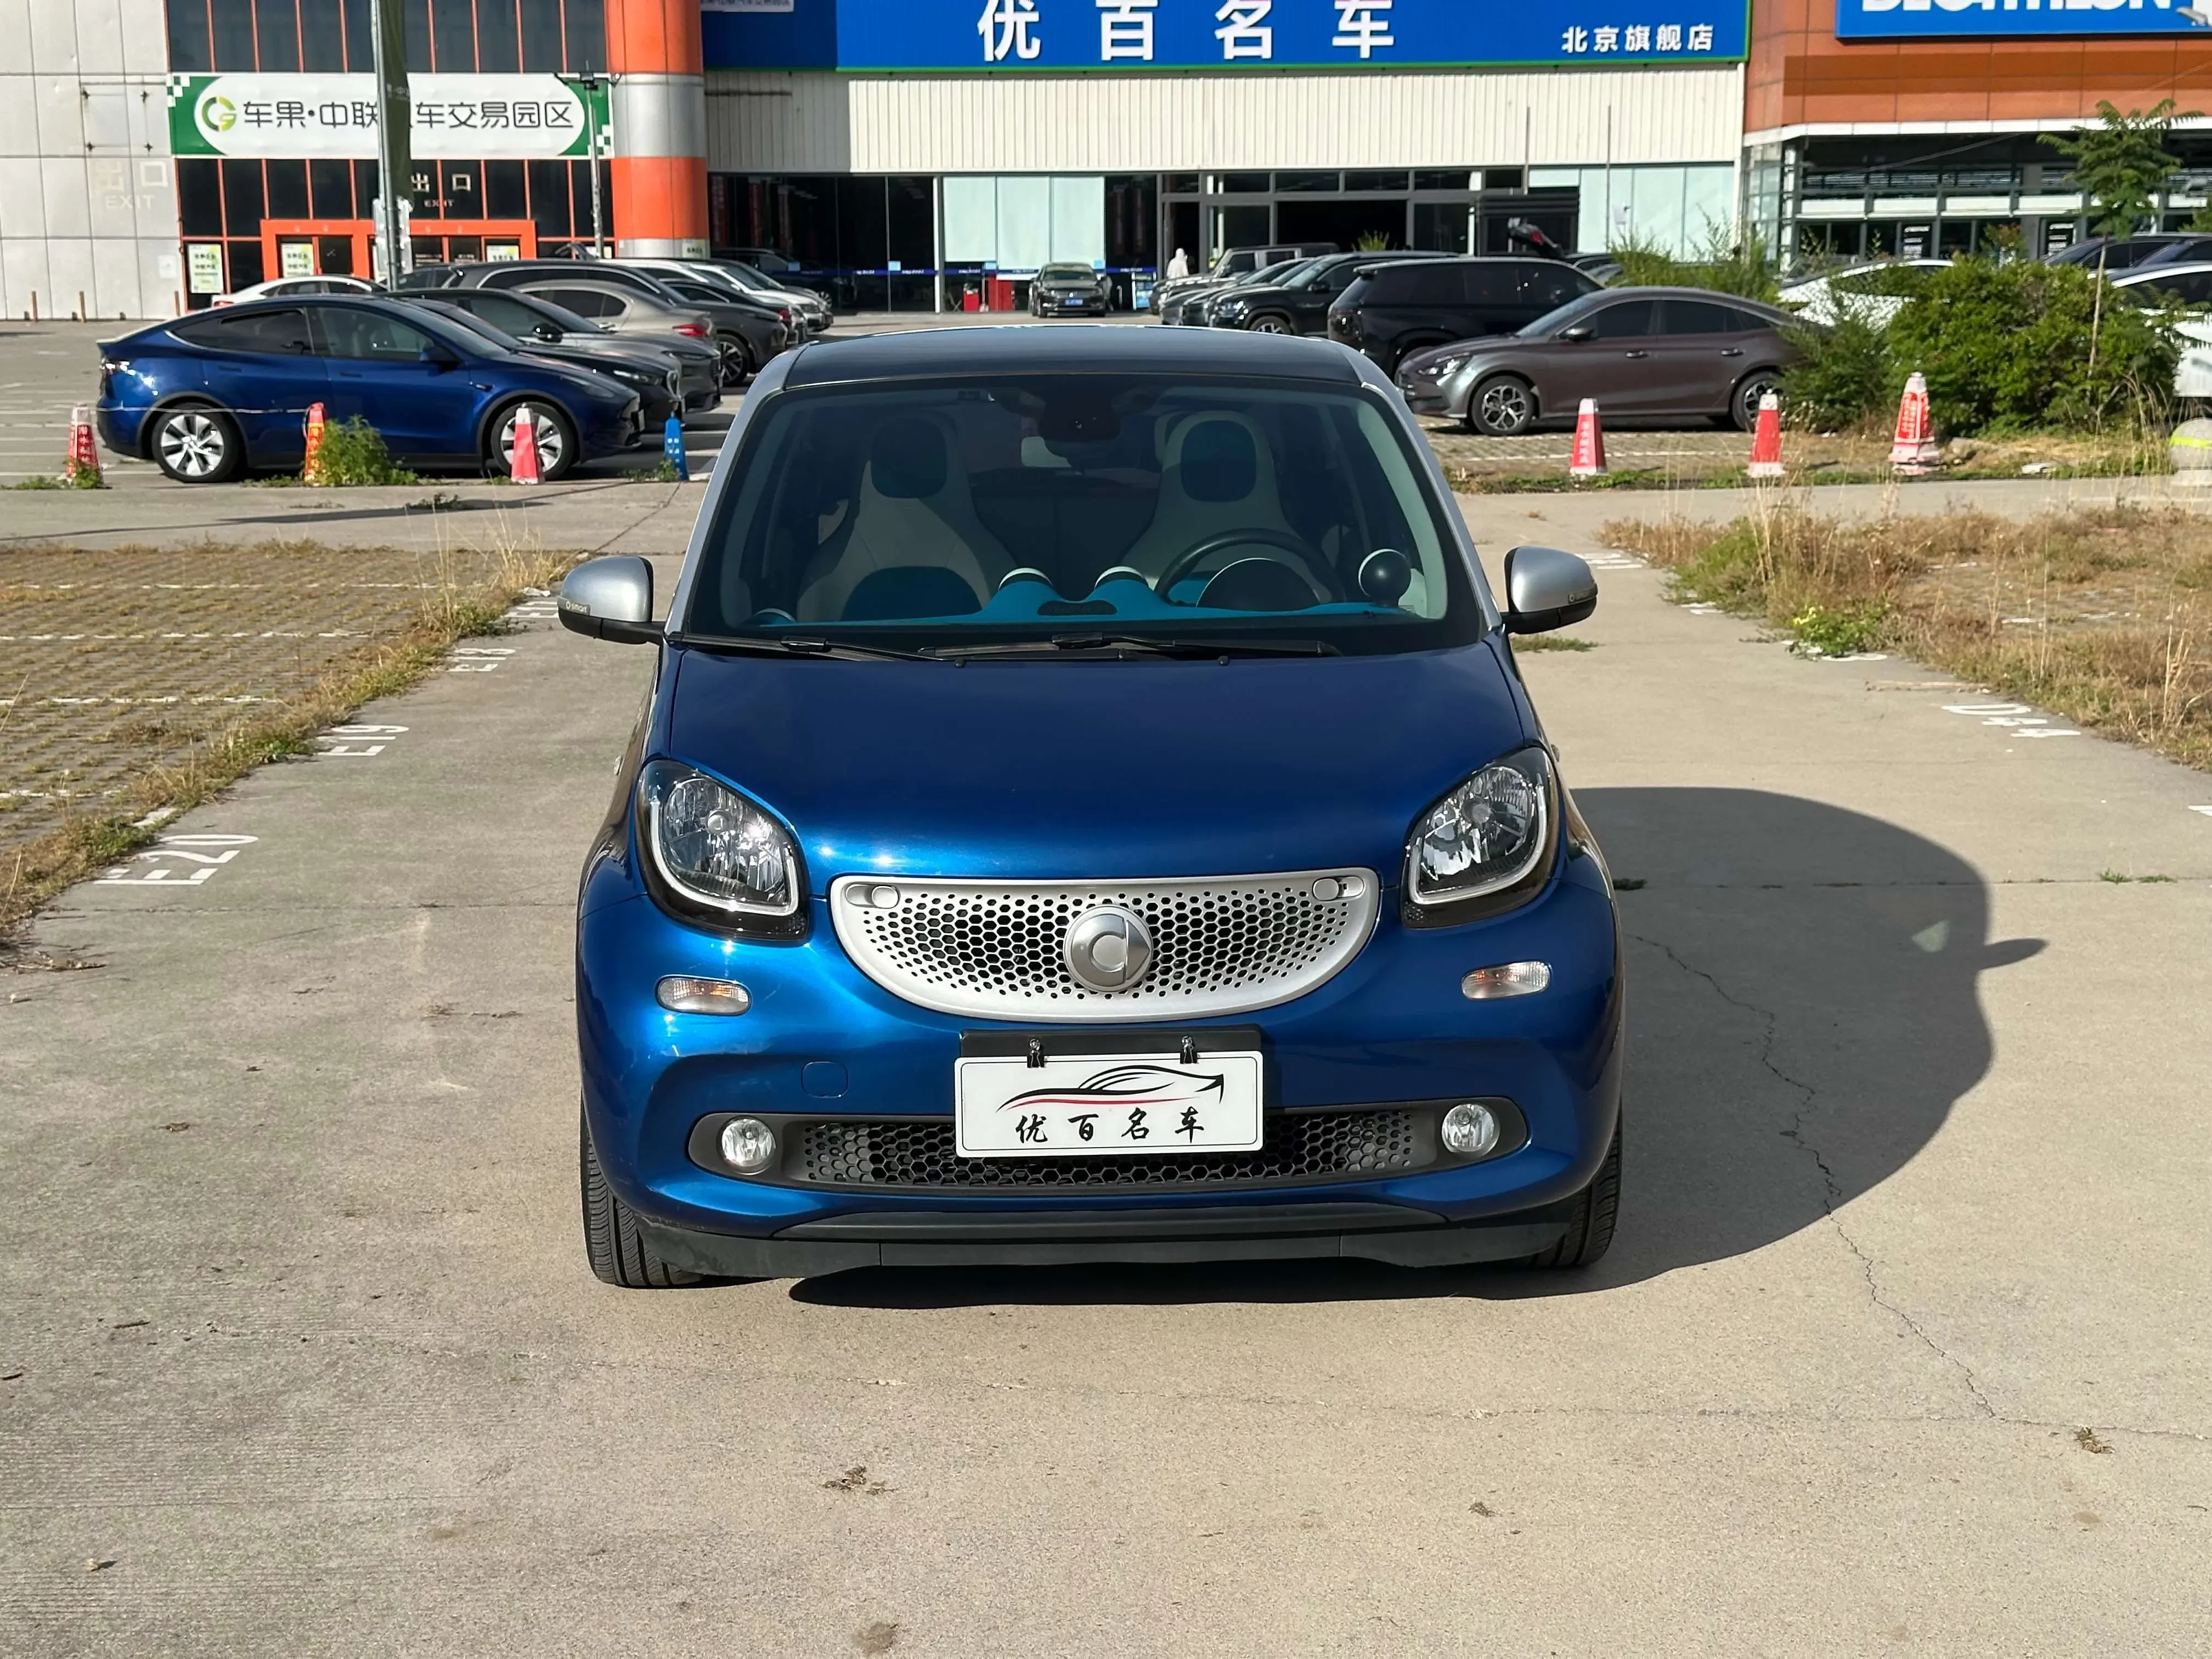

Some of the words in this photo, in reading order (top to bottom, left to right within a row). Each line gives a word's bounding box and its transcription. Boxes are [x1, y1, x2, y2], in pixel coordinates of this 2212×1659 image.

[977, 0, 1394, 62] 优百名车
[1561, 24, 1714, 54] 北京旗舰店
[243, 100, 573, 129] 车果·中联车交易园区
[410, 172, 471, 193] 出口
[105, 194, 155, 210] EXIT
[92, 833, 259, 885] E20
[1015, 1106, 1205, 1144] 优百名车
